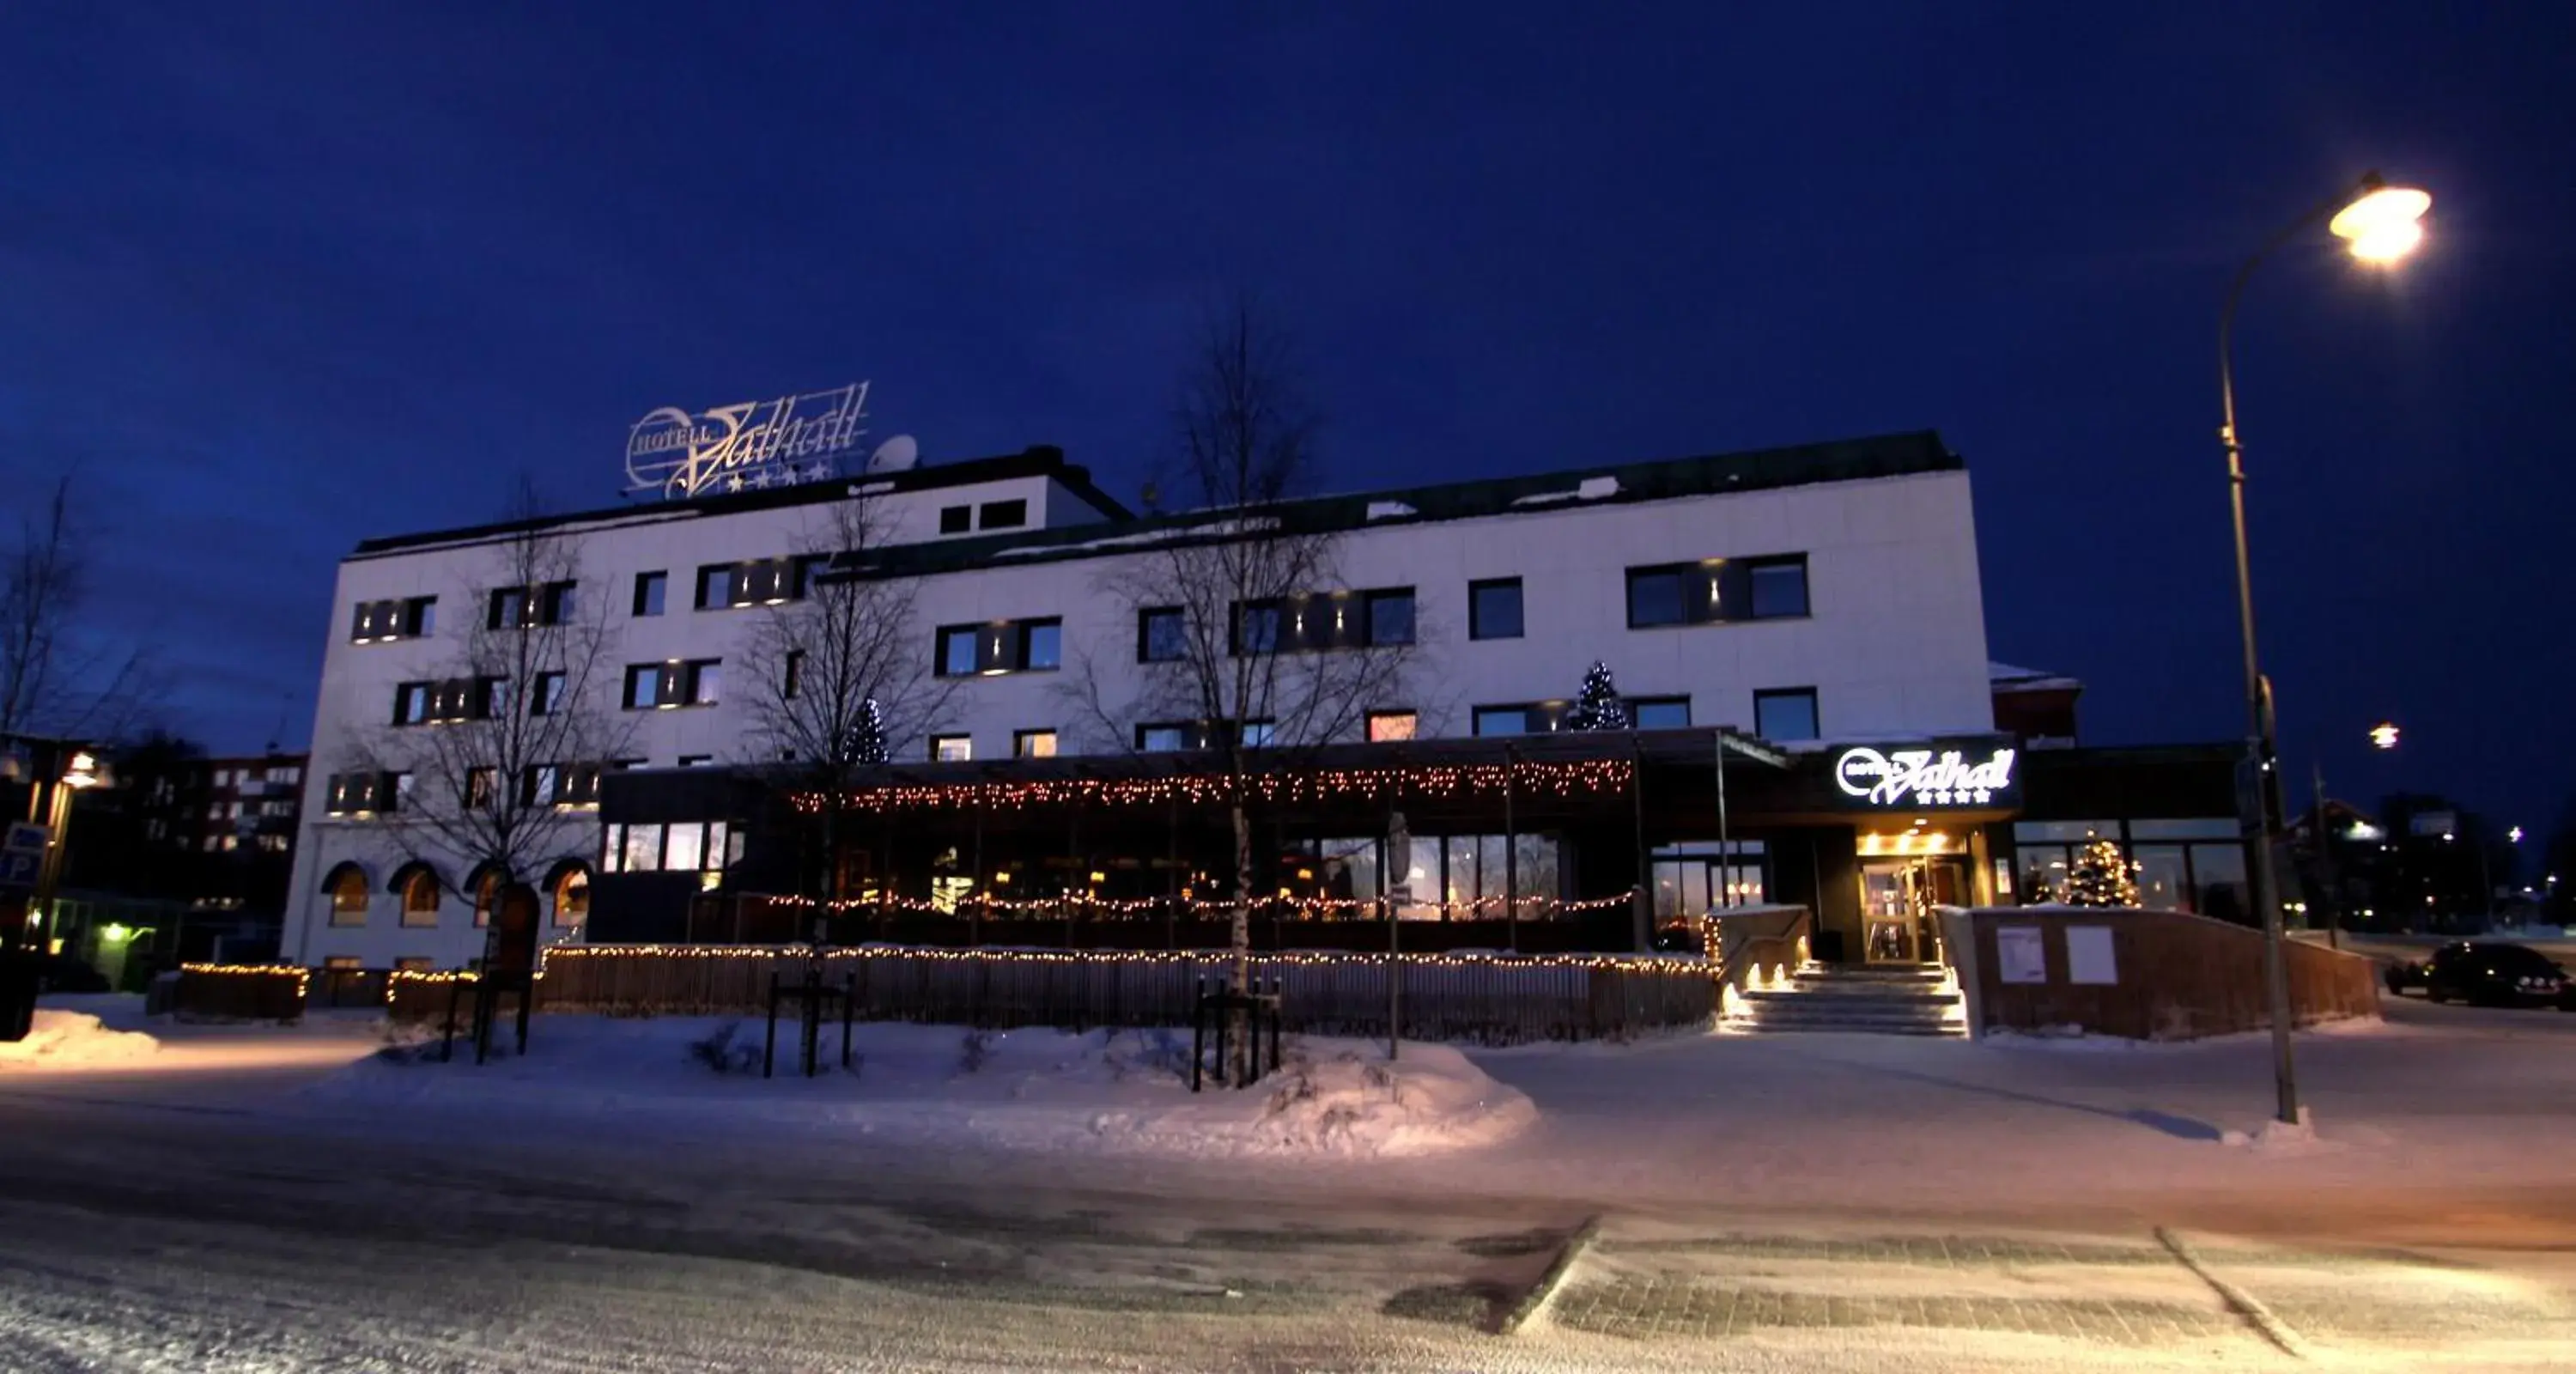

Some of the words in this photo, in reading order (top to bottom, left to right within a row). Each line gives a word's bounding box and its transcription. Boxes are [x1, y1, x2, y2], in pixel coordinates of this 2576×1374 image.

[636, 426, 711, 452] HOTELL
[665, 381, 869, 500] Valhall
[9, 855, 33, 879] P
